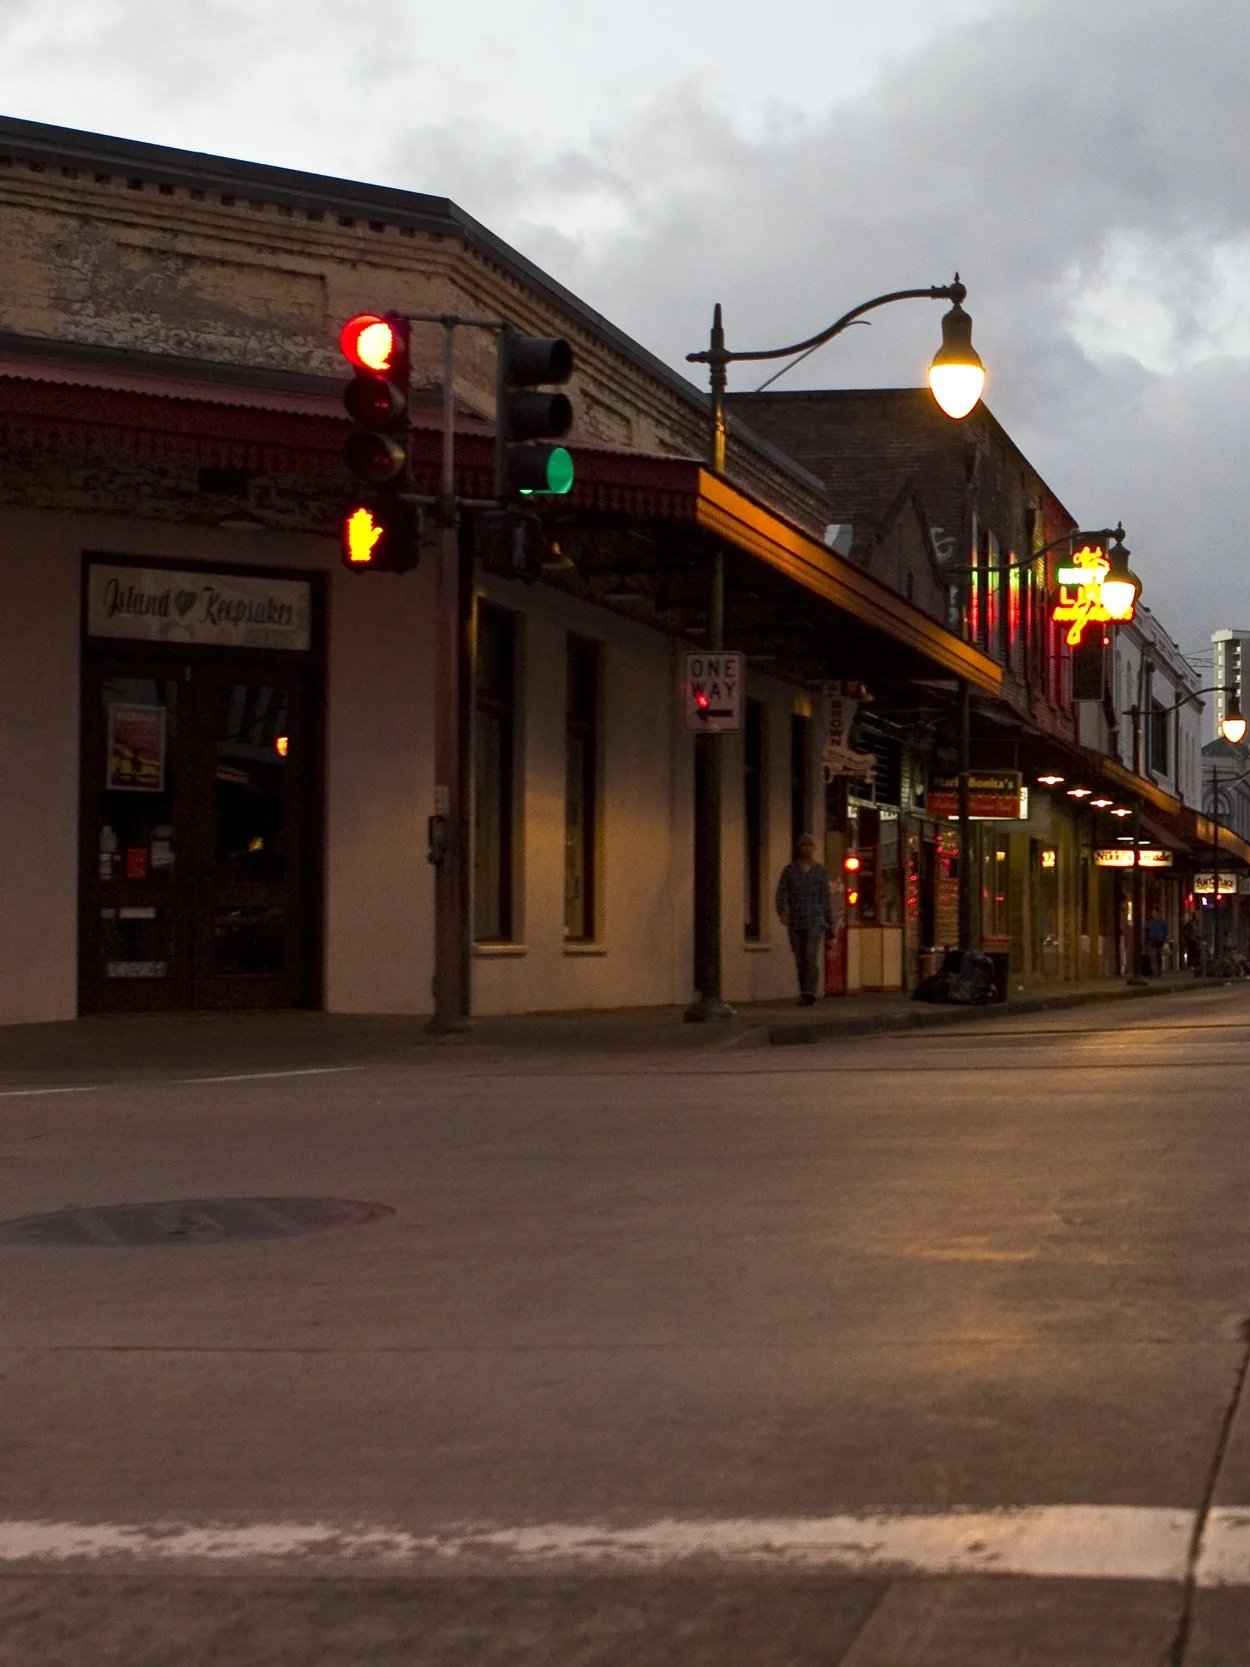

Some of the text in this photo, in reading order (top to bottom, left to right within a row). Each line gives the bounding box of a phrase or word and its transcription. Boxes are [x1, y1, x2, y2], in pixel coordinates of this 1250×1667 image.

[104, 578, 294, 626] Island Keepsakes
[691, 660, 736, 677] ONE
[691, 682, 736, 699] WAY
[968, 776, 1014, 790] Bonita's
[1139, 851, 1171, 862] rcade
